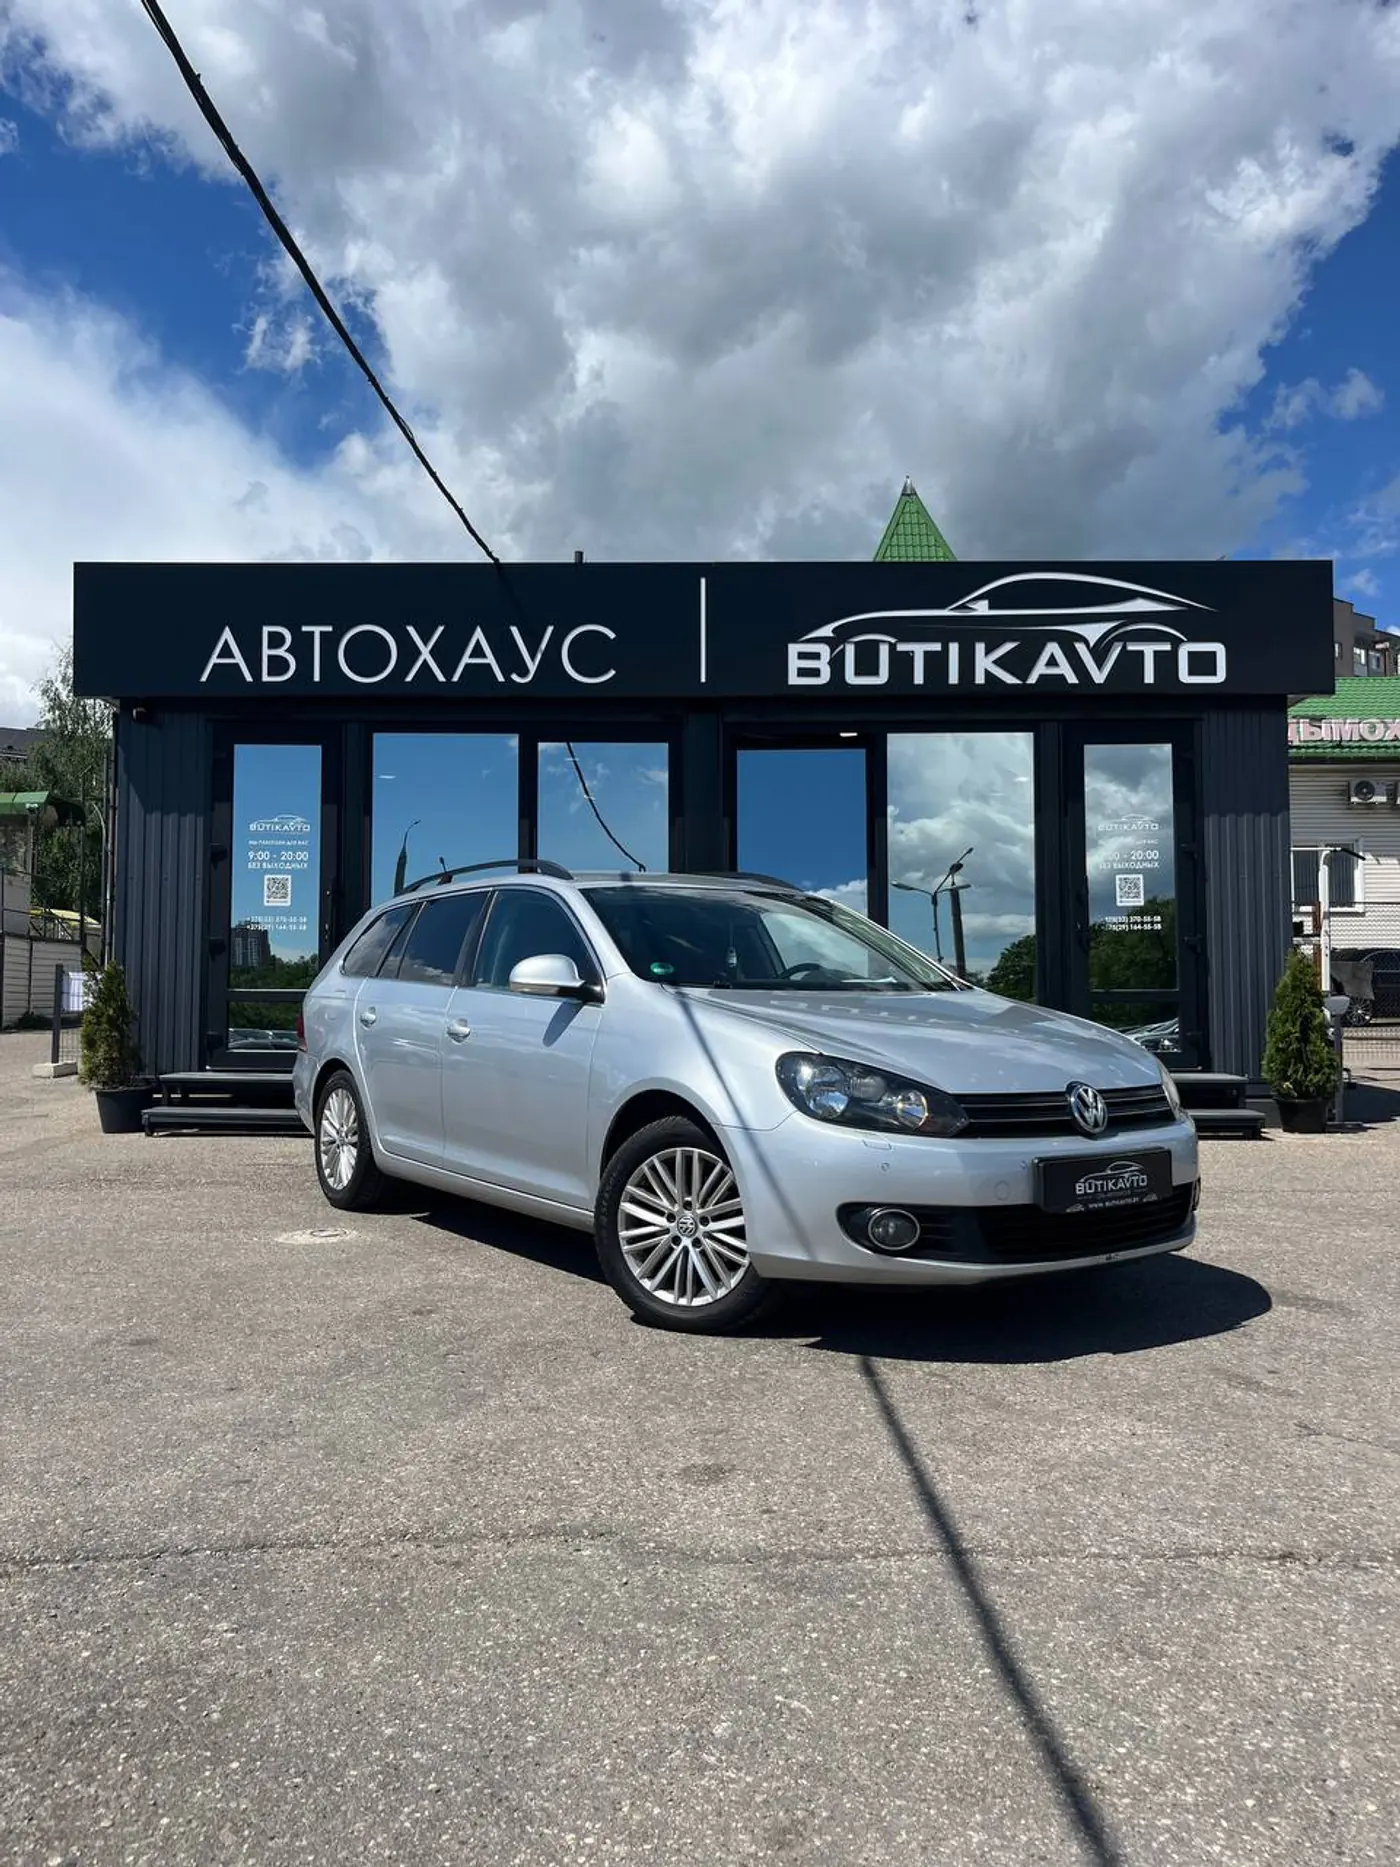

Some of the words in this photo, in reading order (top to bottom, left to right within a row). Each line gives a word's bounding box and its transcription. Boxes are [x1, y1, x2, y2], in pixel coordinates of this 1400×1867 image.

[199, 624, 616, 685] АВТОХАУС
[788, 641, 1227, 685] BUTIKAVTO
[248, 850, 270, 861] 9:00
[280, 850, 309, 861] 20:00
[1130, 849, 1160, 860] 20:00
[1075, 1174, 1148, 1195] BUTIKAVTO
